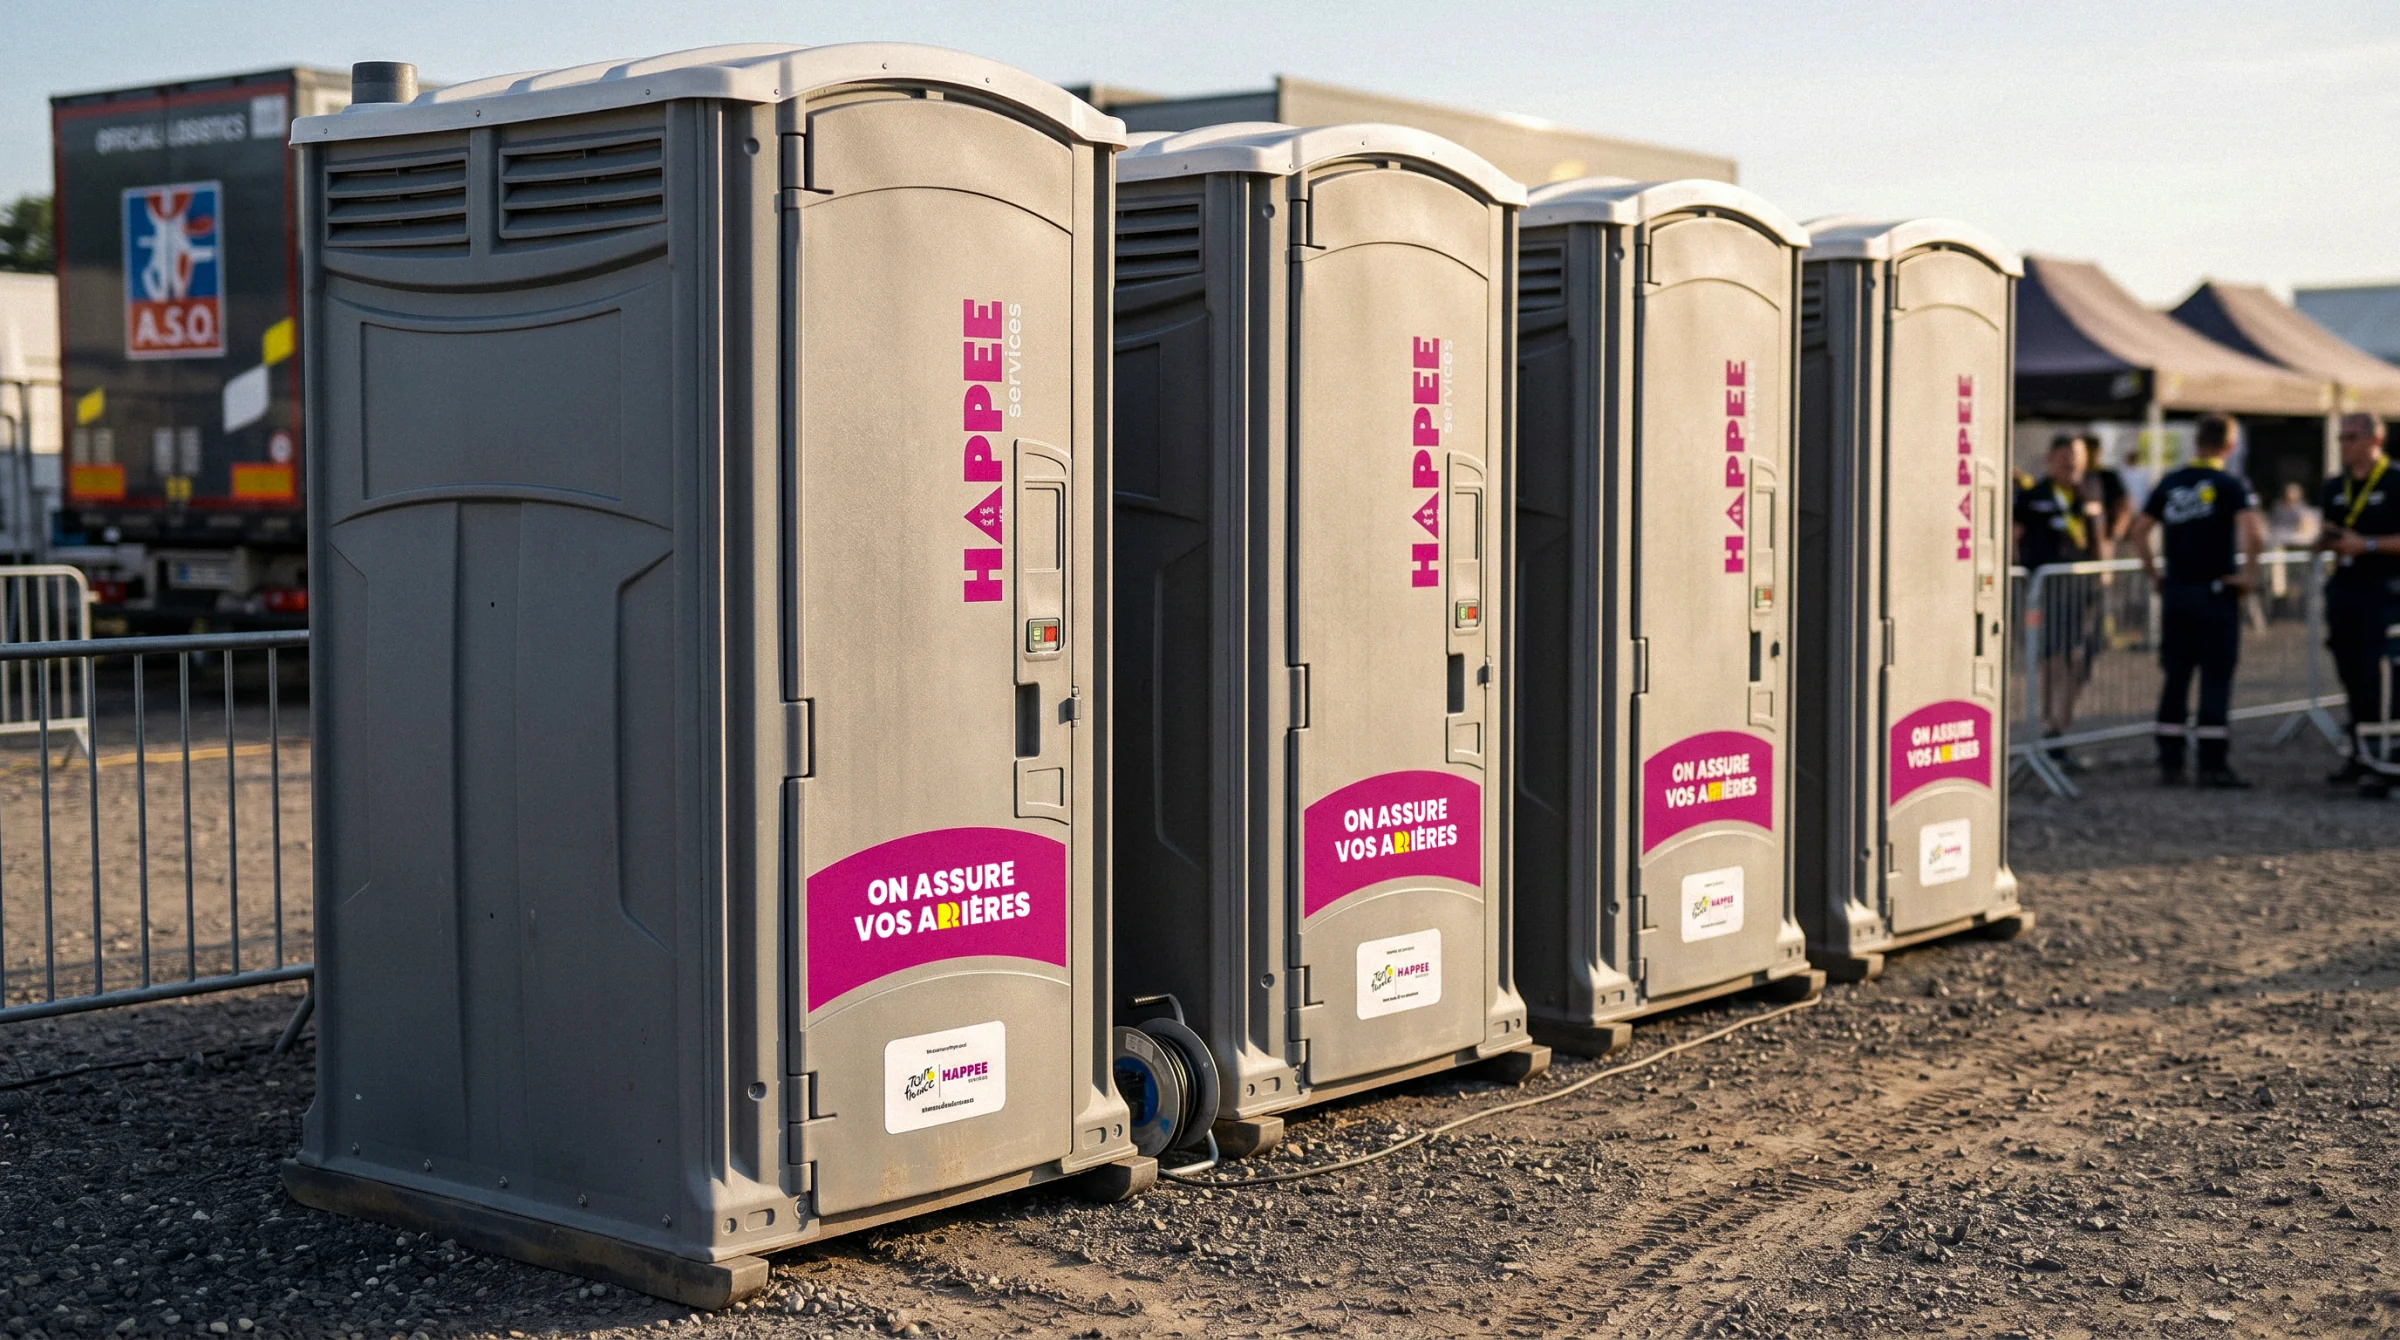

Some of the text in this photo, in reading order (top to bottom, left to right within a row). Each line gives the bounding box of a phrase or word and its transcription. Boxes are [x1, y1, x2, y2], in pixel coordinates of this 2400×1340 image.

[1006, 303, 1022, 418] services
[1443, 339, 1453, 433] services
[963, 299, 1003, 602] HAPPEE
[1412, 336, 1440, 588] HAPPEE
[1725, 360, 1745, 573] HAPPEE
[1672, 753, 1750, 783] ON ASSURE
[1344, 798, 1448, 832] ON ASSURE
[1665, 785, 1695, 809] VOS
[1335, 824, 1458, 863] VOS ARRIÈRES
[867, 861, 1015, 906] ON ASSURE
[854, 892, 1031, 942] VOS ARRIÈRES
[1397, 962, 1429, 977] HAPPEE
[942, 1061, 988, 1082] HAPPEE
